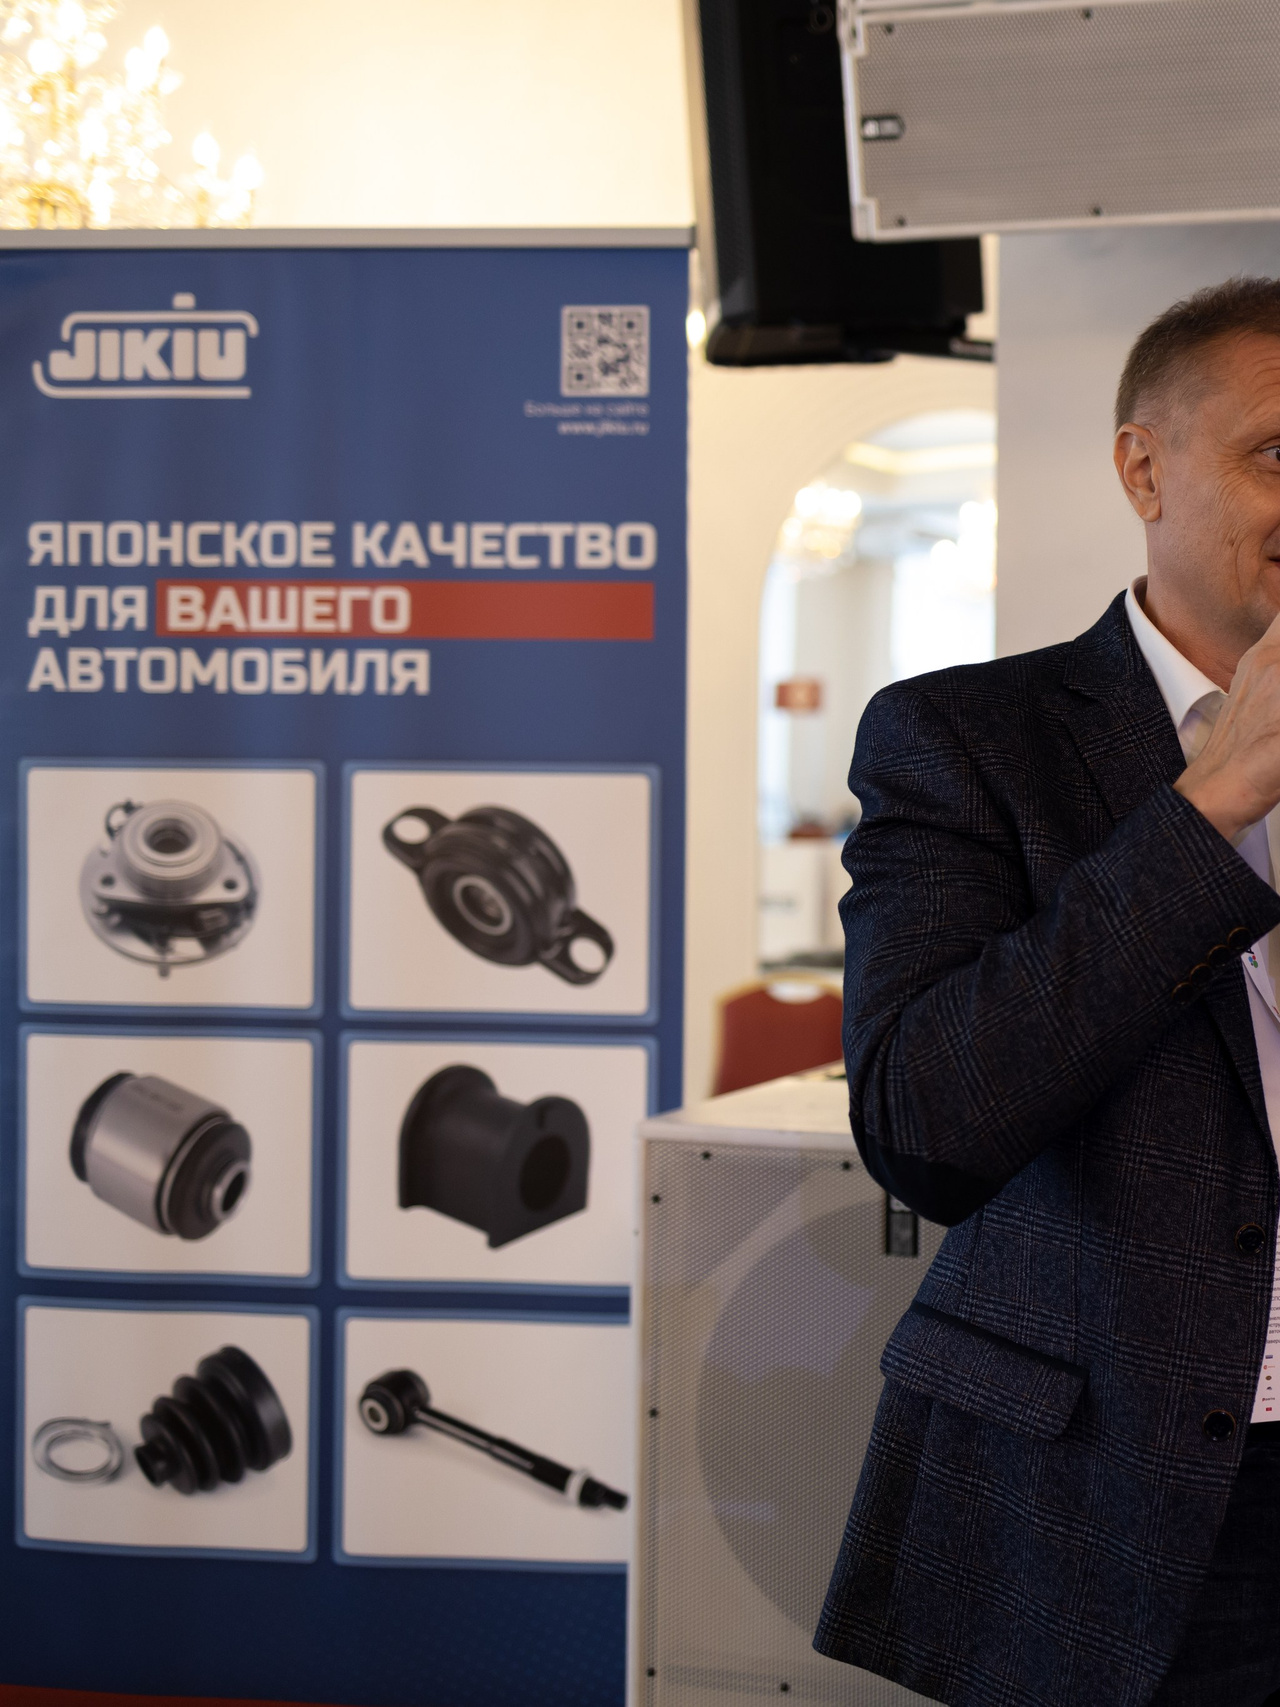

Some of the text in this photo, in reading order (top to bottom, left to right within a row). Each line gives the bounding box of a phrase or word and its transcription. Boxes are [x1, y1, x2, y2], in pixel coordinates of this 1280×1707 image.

[49, 293, 247, 382] JIKIU
[27, 521, 657, 569] ЯПОНСКОЕ КАЧЕСТВО
[27, 585, 412, 637] ДЛЯ ВАШЕГО
[27, 647, 430, 695] АВТОМОБИЛЯ
